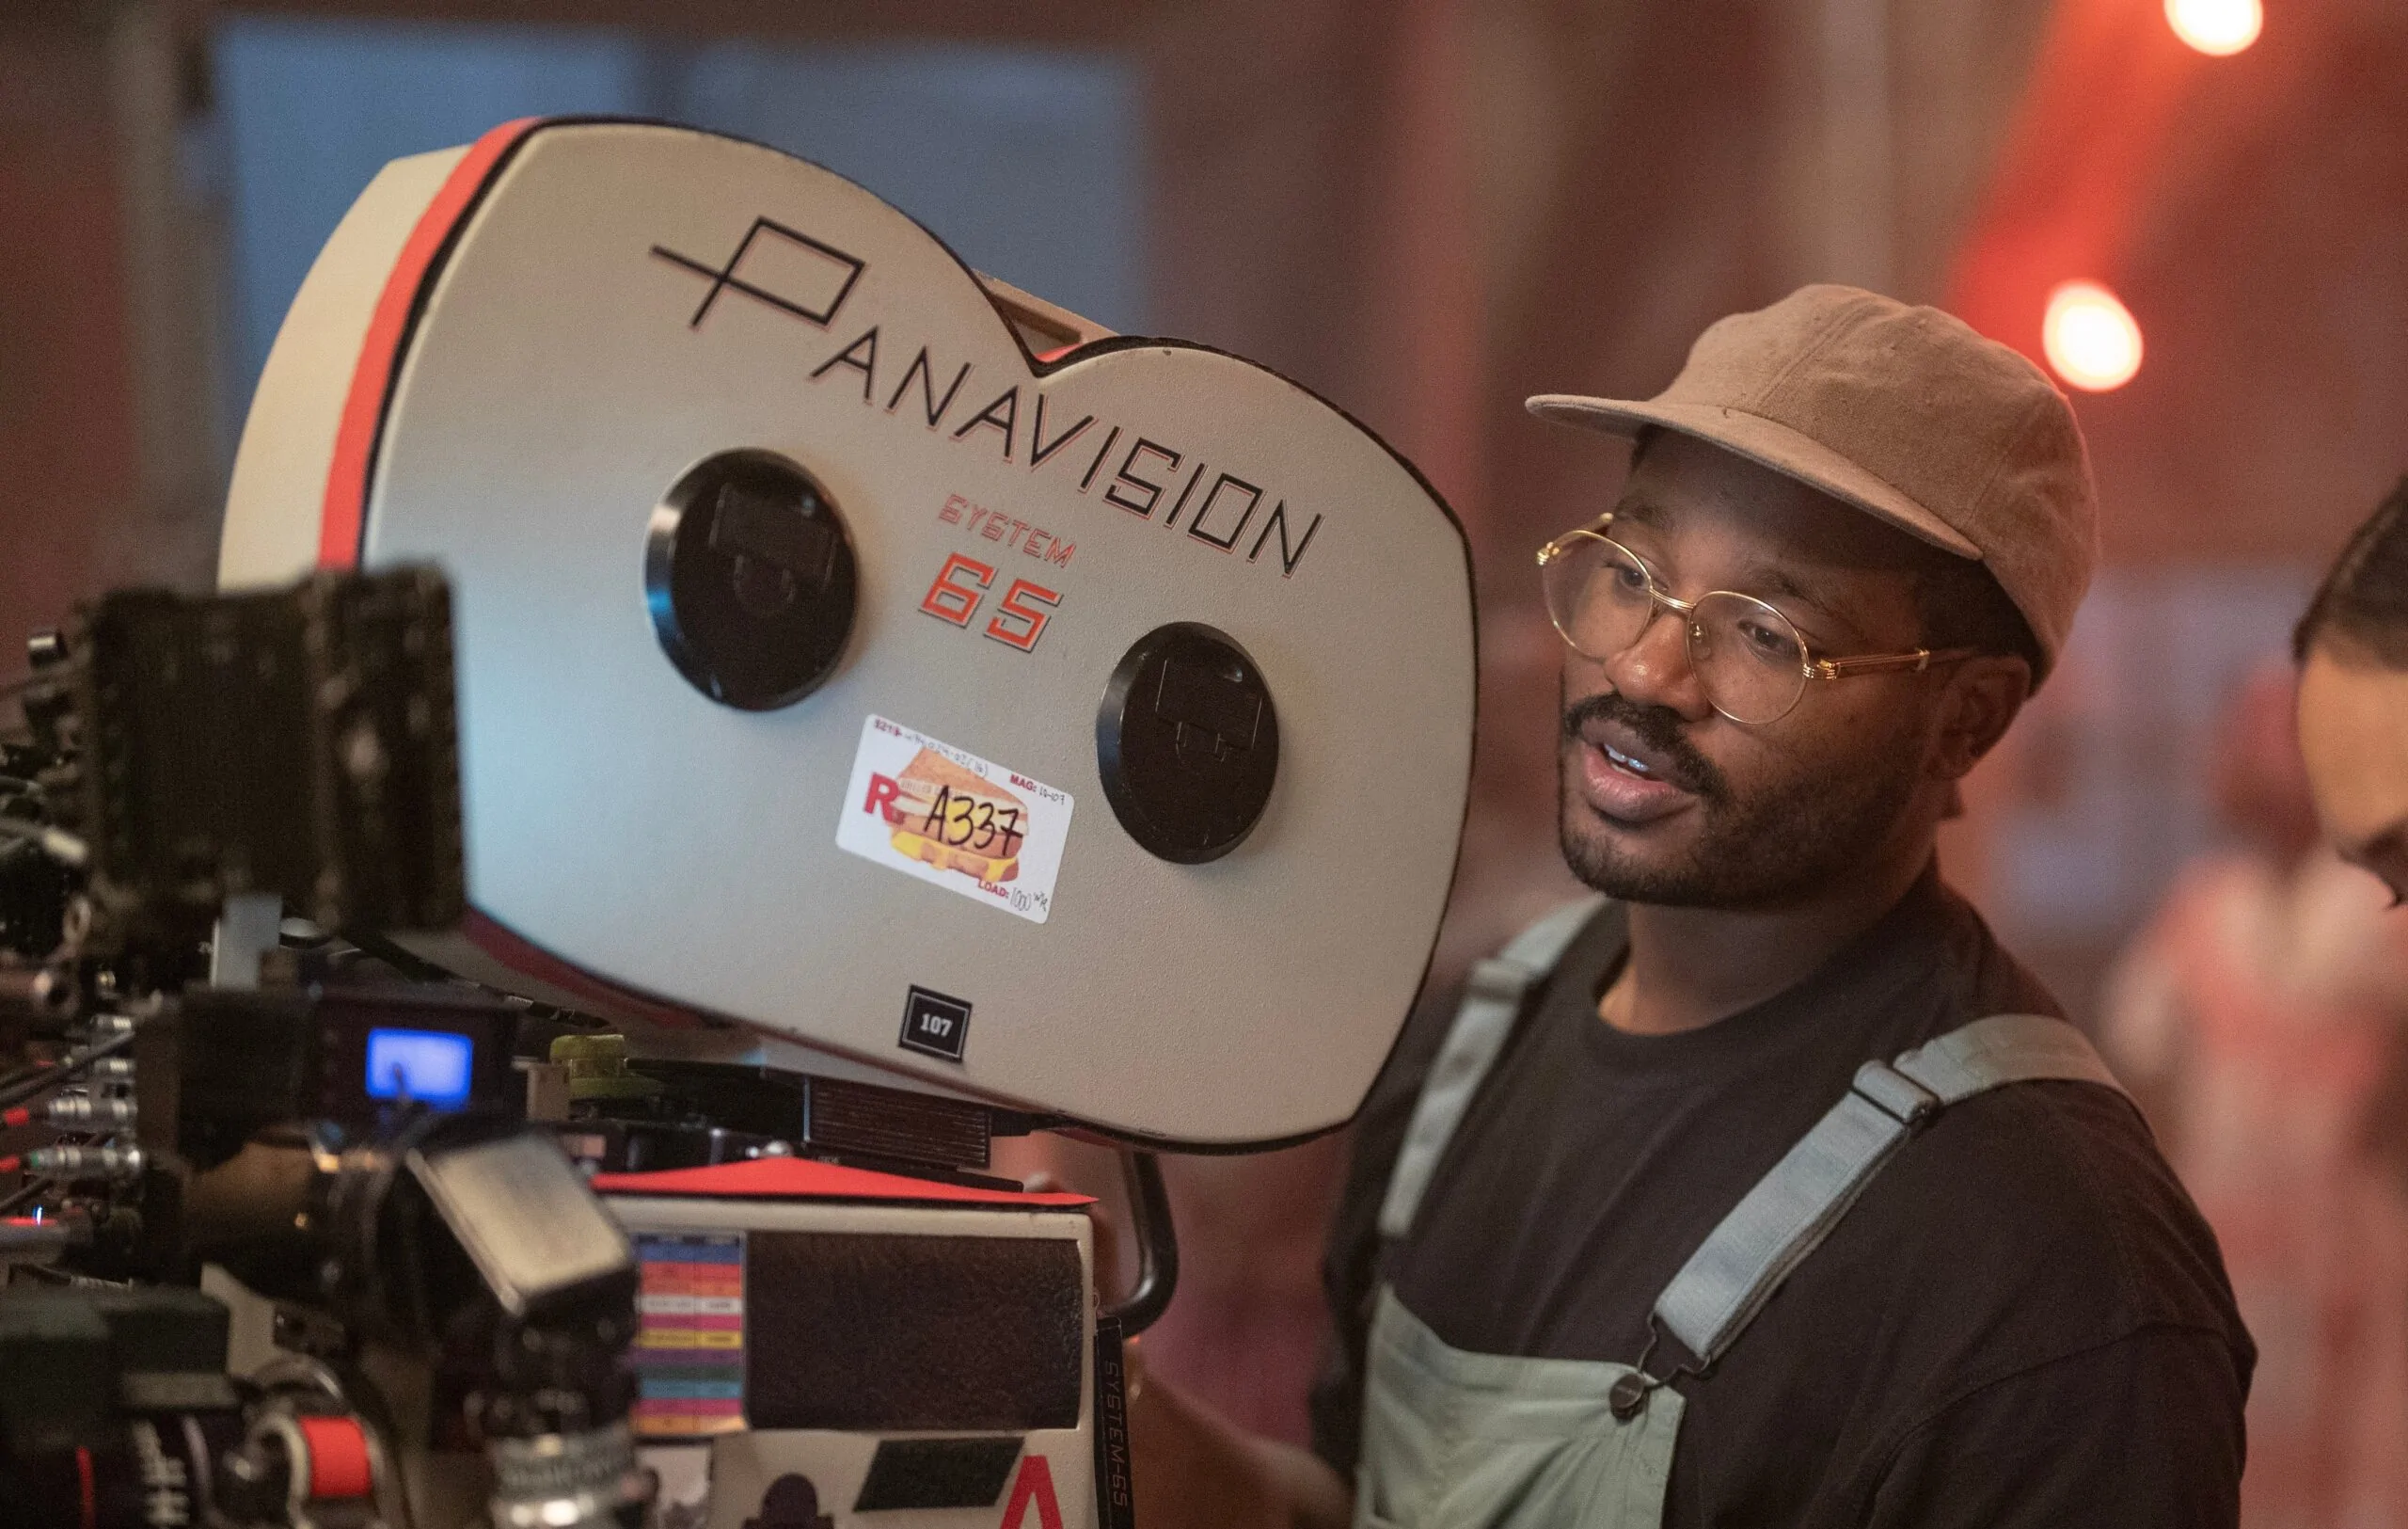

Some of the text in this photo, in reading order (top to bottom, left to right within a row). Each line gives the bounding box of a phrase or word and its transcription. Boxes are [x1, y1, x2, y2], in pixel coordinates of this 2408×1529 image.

[650, 215, 1323, 578] PANAVISION
[937, 493, 1077, 569] SYSTEM
[917, 551, 1065, 654] 65
[1009, 773, 1038, 793] MAG:
[924, 784, 1023, 857] A337
[977, 879, 1009, 900] LOAD:
[920, 1012, 953, 1037] 107
[1104, 1360, 1129, 1507] SYSTEM-65
